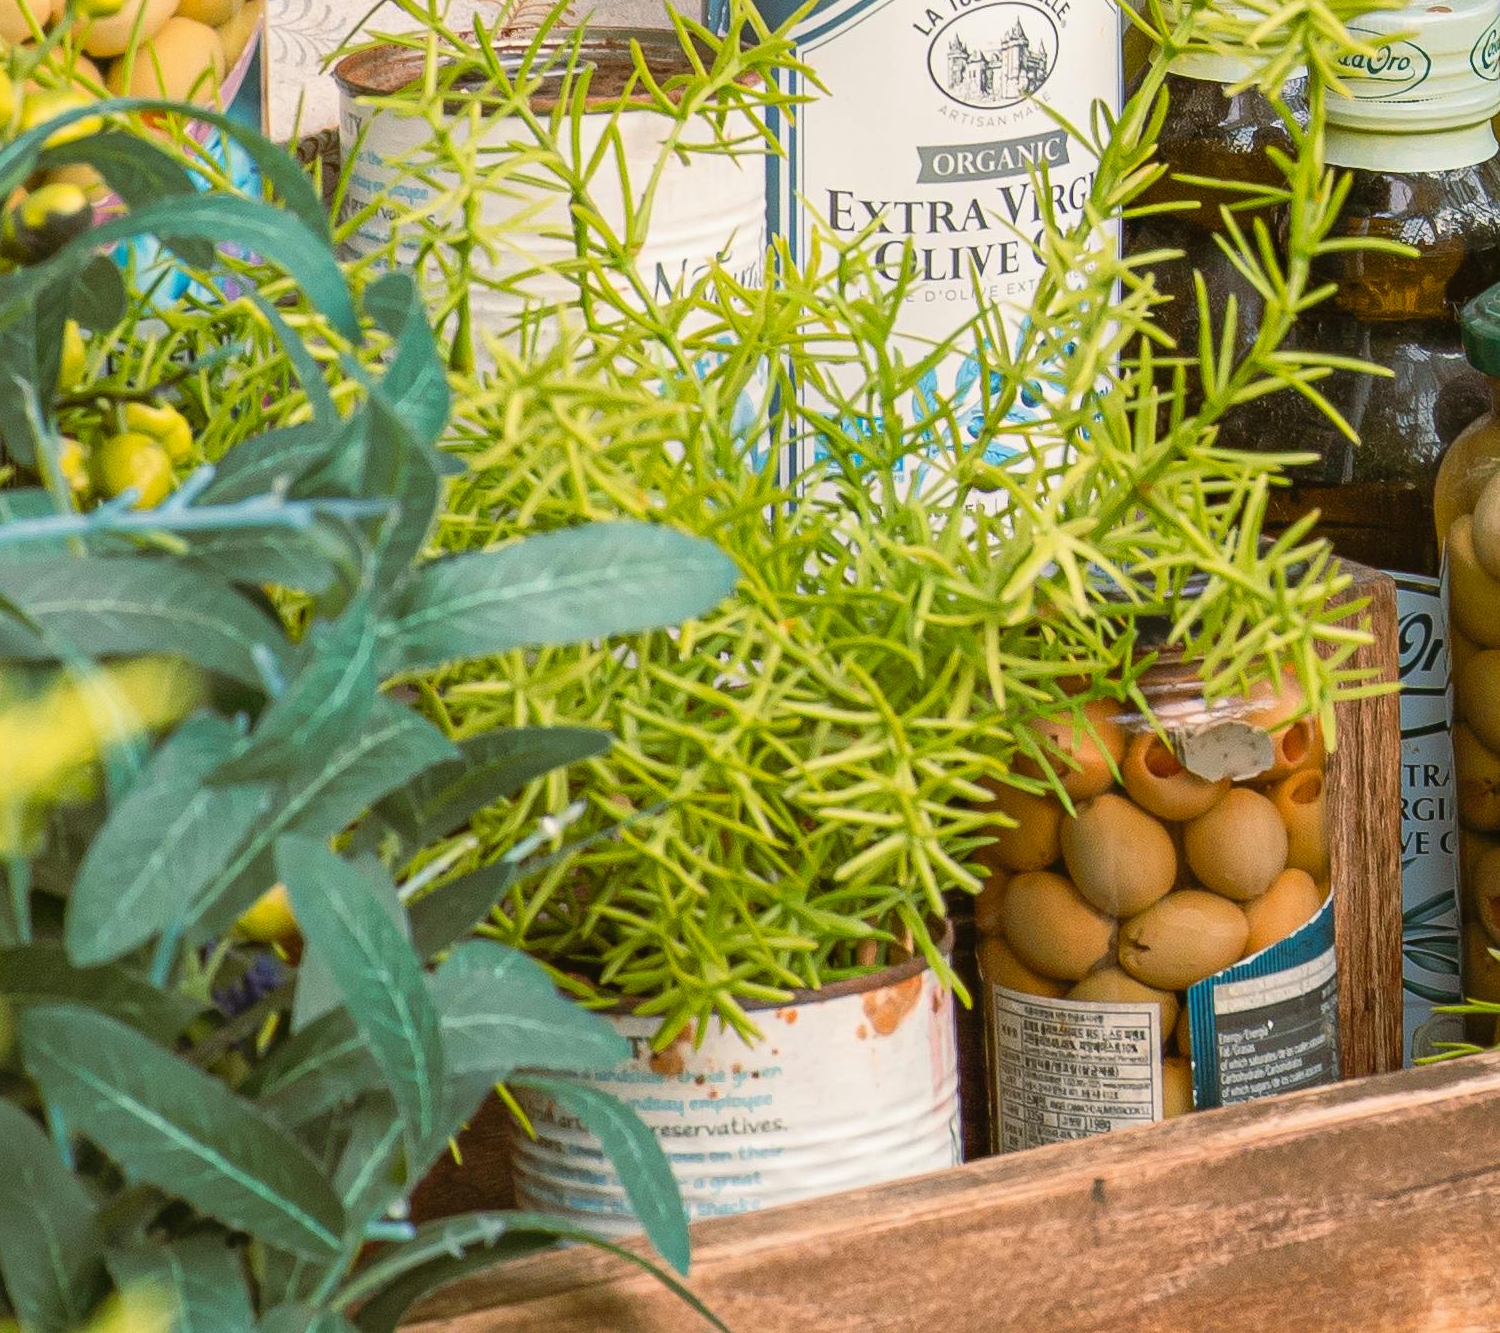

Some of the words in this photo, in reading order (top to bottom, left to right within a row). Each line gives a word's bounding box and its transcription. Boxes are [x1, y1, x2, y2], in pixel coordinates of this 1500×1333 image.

[913, 7, 944, 37] LA
[938, 104, 1007, 128] ARTISAN
[932, 137, 1061, 176] ORGANIC
[825, 188, 991, 235] EXTRA
[875, 239, 1020, 283] OLIVE
[1007, 280, 1035, 296] EXT
[650, 1115, 789, 1138] reservatives.
